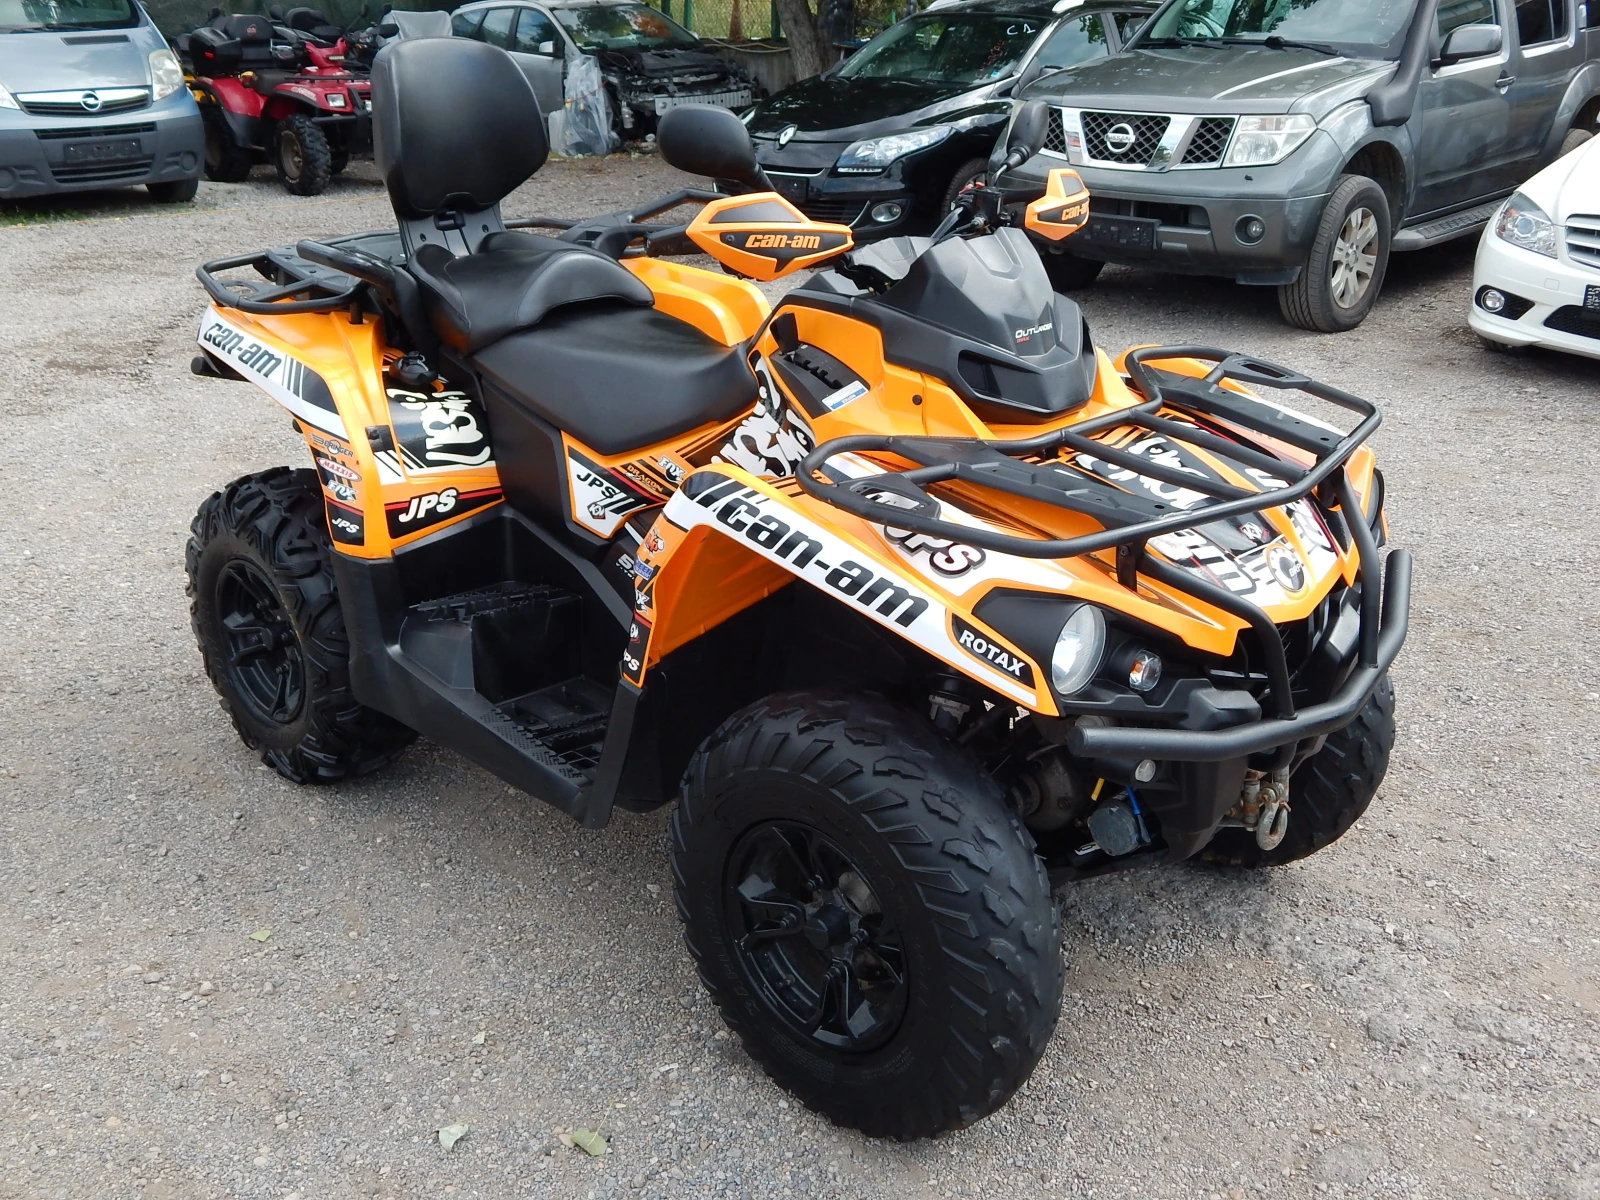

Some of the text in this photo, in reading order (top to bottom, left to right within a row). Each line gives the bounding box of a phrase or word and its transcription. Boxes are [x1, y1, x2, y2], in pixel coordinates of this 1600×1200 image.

[1061, 202, 1089, 221] can-a
[745, 234, 820, 249] can-am
[203, 322, 282, 379] can-am
[323, 460, 353, 479] MAXXIS
[627, 464, 664, 493] DRAGON
[658, 456, 685, 480] FOX
[327, 480, 358, 500] FOX
[576, 472, 620, 499] JPS
[398, 488, 458, 523] JPS
[332, 517, 360, 534] JPS
[716, 497, 930, 628] can-am
[959, 629, 1026, 677] ROTAX
